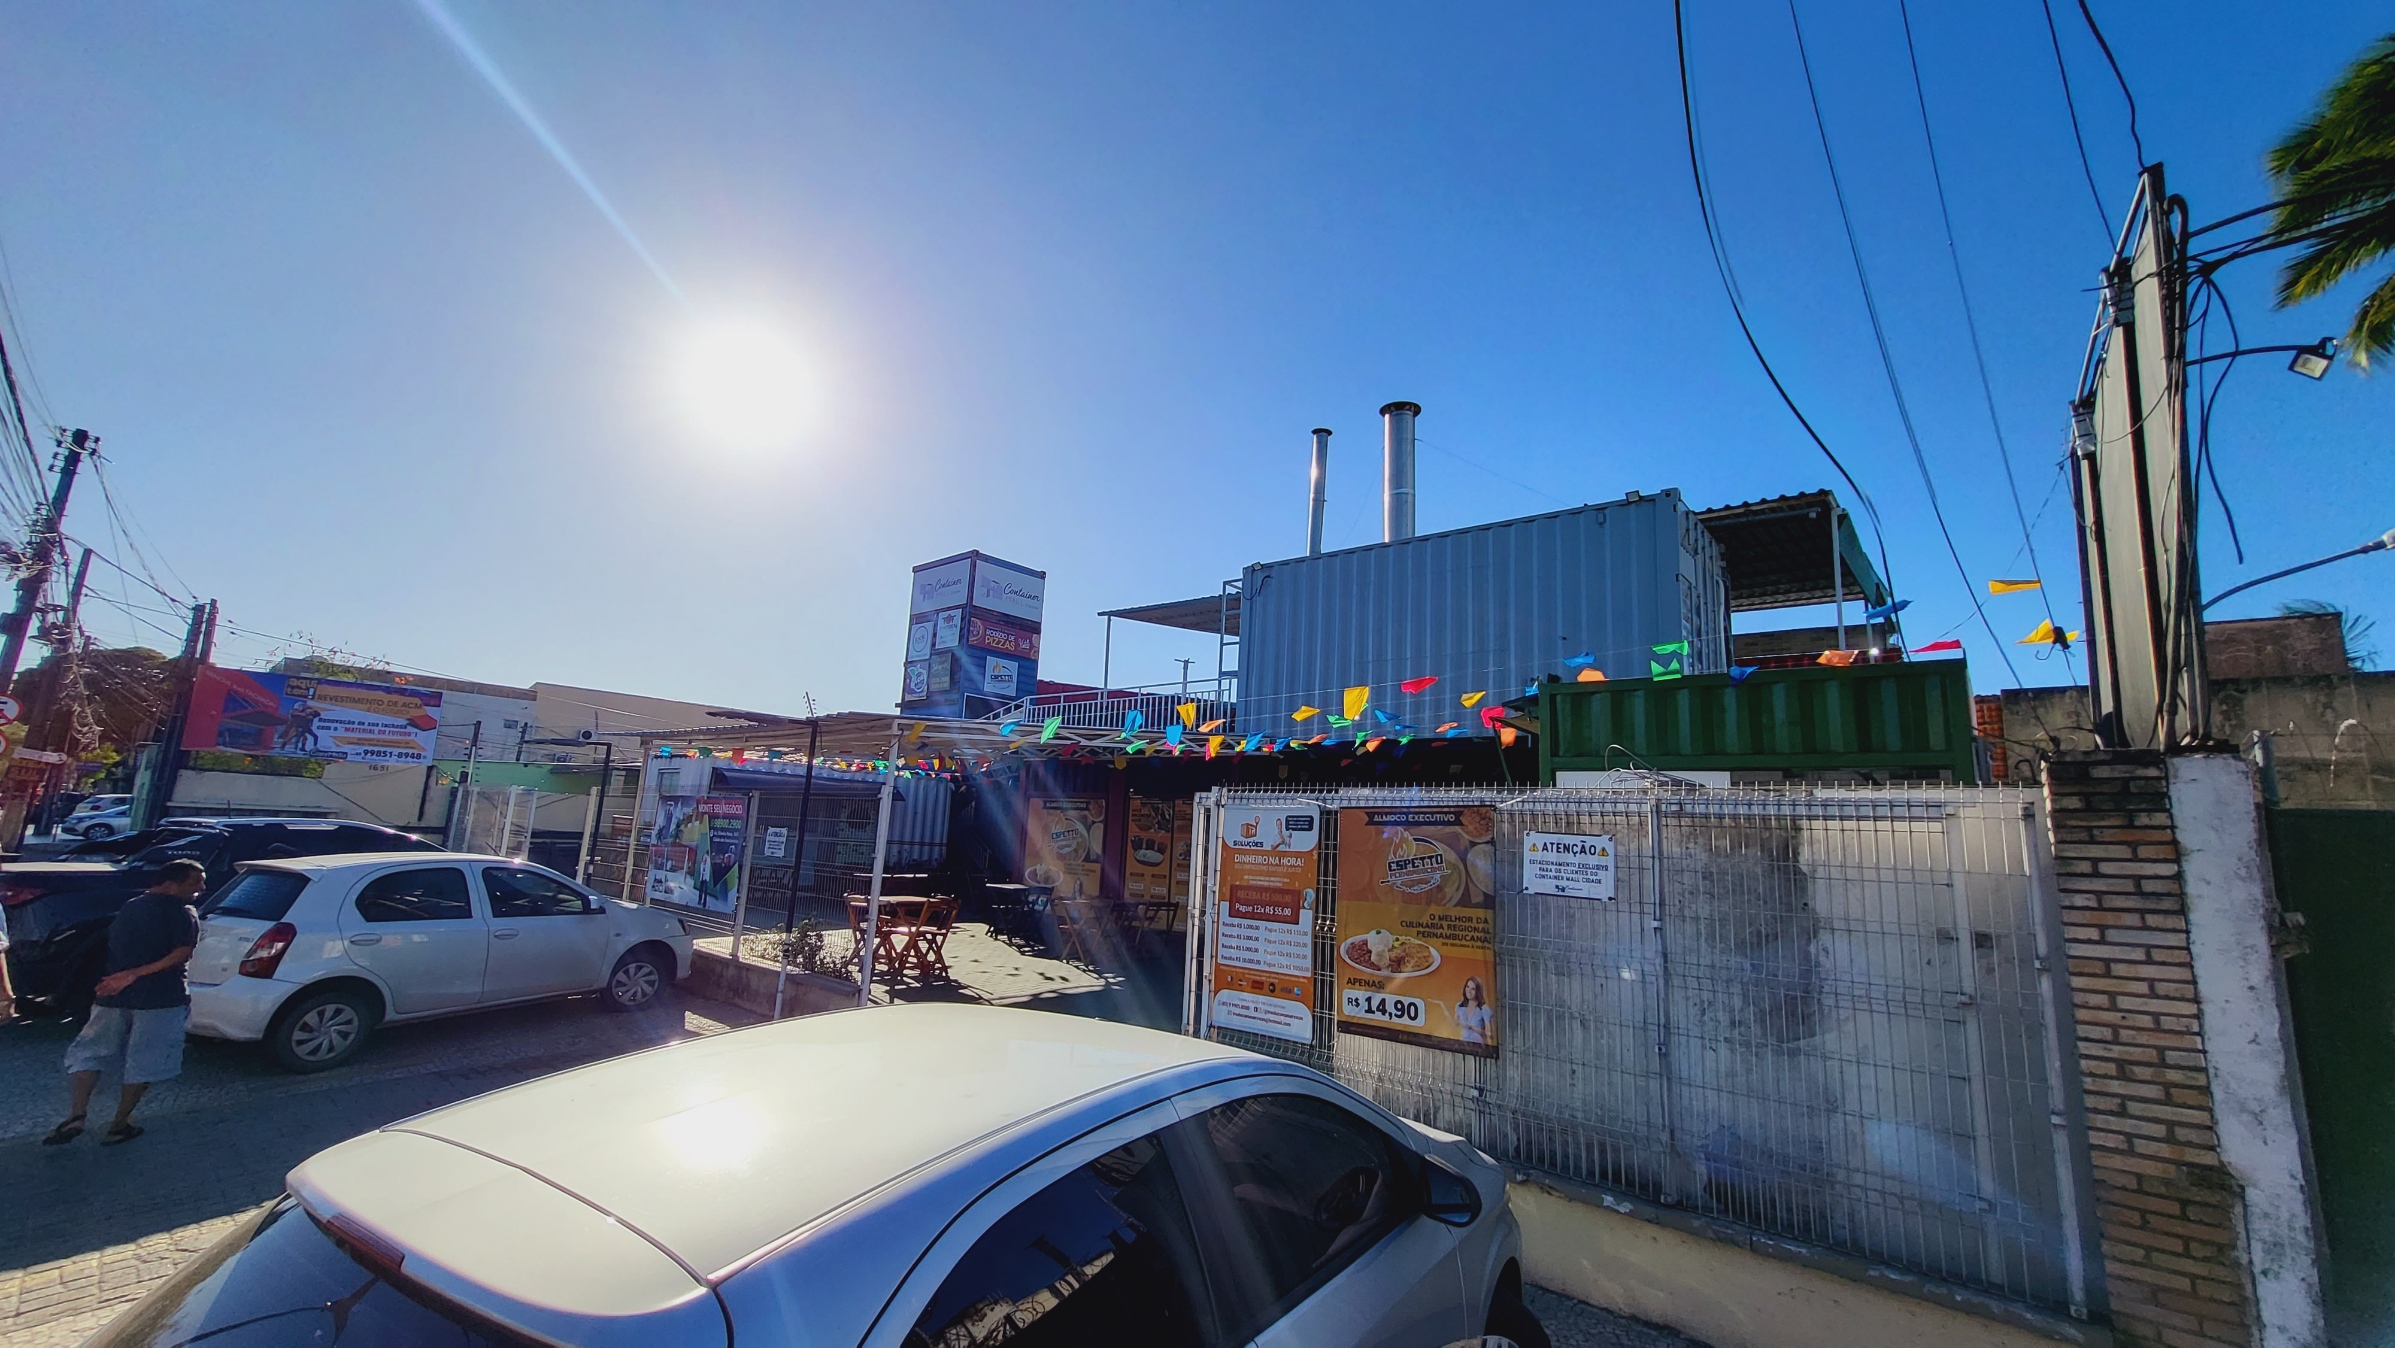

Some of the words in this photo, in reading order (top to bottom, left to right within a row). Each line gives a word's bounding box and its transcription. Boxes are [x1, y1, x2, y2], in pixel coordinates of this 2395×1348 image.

[1003, 582, 1041, 602] Container
[985, 636, 1015, 651] PIZZAS
[1008, 634, 1016, 642] DE
[317, 694, 385, 707] REVESTIMENTO
[387, 698, 399, 708] DE
[400, 700, 423, 710] ACM
[363, 748, 422, 760] 99851-8948
[698, 803, 713, 813] MONTE
[1408, 813, 1456, 822] EXECUTIVO
[1052, 828, 1079, 840] ESPETTO
[1233, 839, 1264, 848] SOLUÇÕES
[1541, 840, 1597, 858] ATENÇÃO
[1234, 854, 1268, 864] DINHEIRO
[1269, 856, 1280, 865] NA
[1280, 857, 1304, 867] HORA!
[1387, 853, 1443, 872] ESPETTO
[1529, 859, 1576, 868] ESTACIONAMENTO
[1534, 873, 1565, 881] CONTAINER
[1237, 890, 1261, 900] RECEBA
[1235, 903, 1252, 913] Pague
[1253, 904, 1264, 914] 12x
[1265, 905, 1274, 915] R$
[1274, 907, 1291, 916] 55,00
[1429, 913, 1436, 921] O
[1438, 914, 1473, 924] MELHOR
[1476, 916, 1489, 925] DA
[1400, 920, 1445, 931] CULINÁRIA
[1447, 923, 1491, 934] REGIONAL
[1416, 930, 1492, 944] PERNAMBUCANA!
[1346, 977, 1385, 990] APENAS:
[1347, 997, 1360, 1008] R$
[1364, 996, 1419, 1021] 14,90
